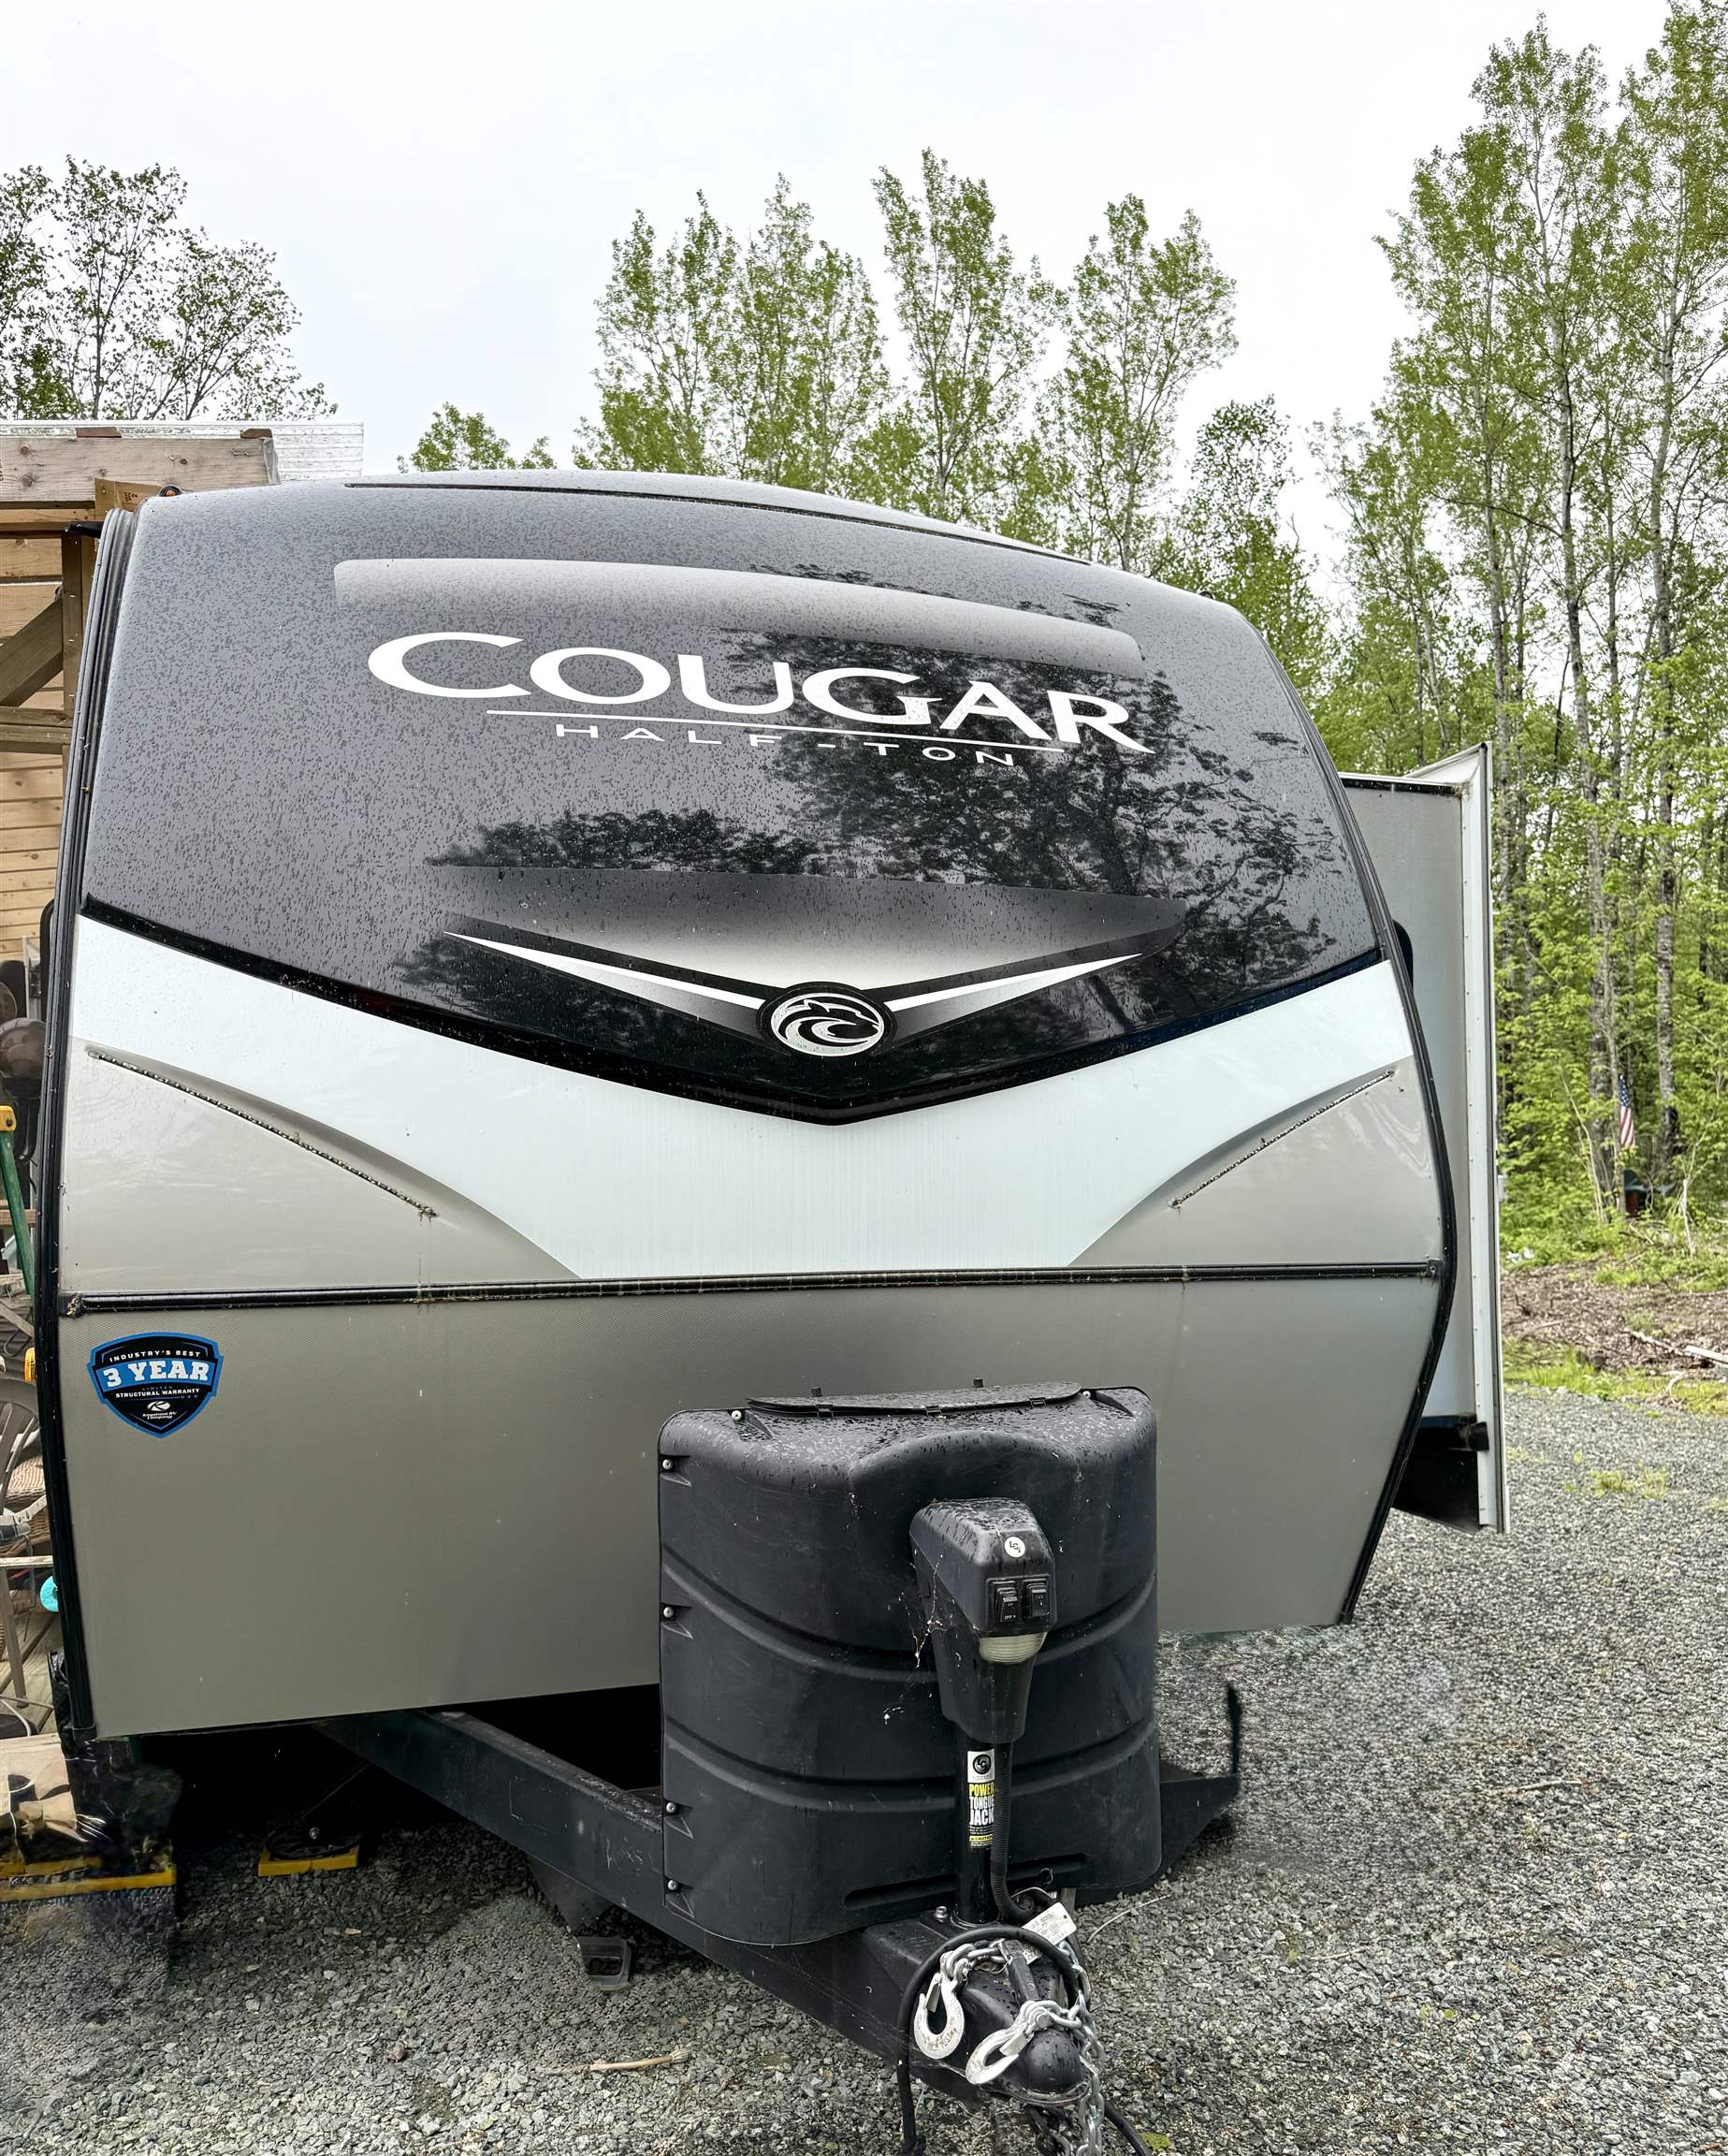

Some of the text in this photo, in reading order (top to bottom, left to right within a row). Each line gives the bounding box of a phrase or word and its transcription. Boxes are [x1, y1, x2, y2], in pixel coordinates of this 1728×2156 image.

[368, 632, 1156, 754] COUGAR
[556, 723, 1014, 766] HALF-TON
[109, 1350, 171, 1362] INDUSTRY'S
[103, 1360, 210, 1388] 3 YEAR
[115, 1390, 160, 1399] STRUCTURAL
[968, 1782, 995, 1797] POWER
[968, 1795, 995, 1810] TONGUE
[968, 1807, 995, 1826] JACK
